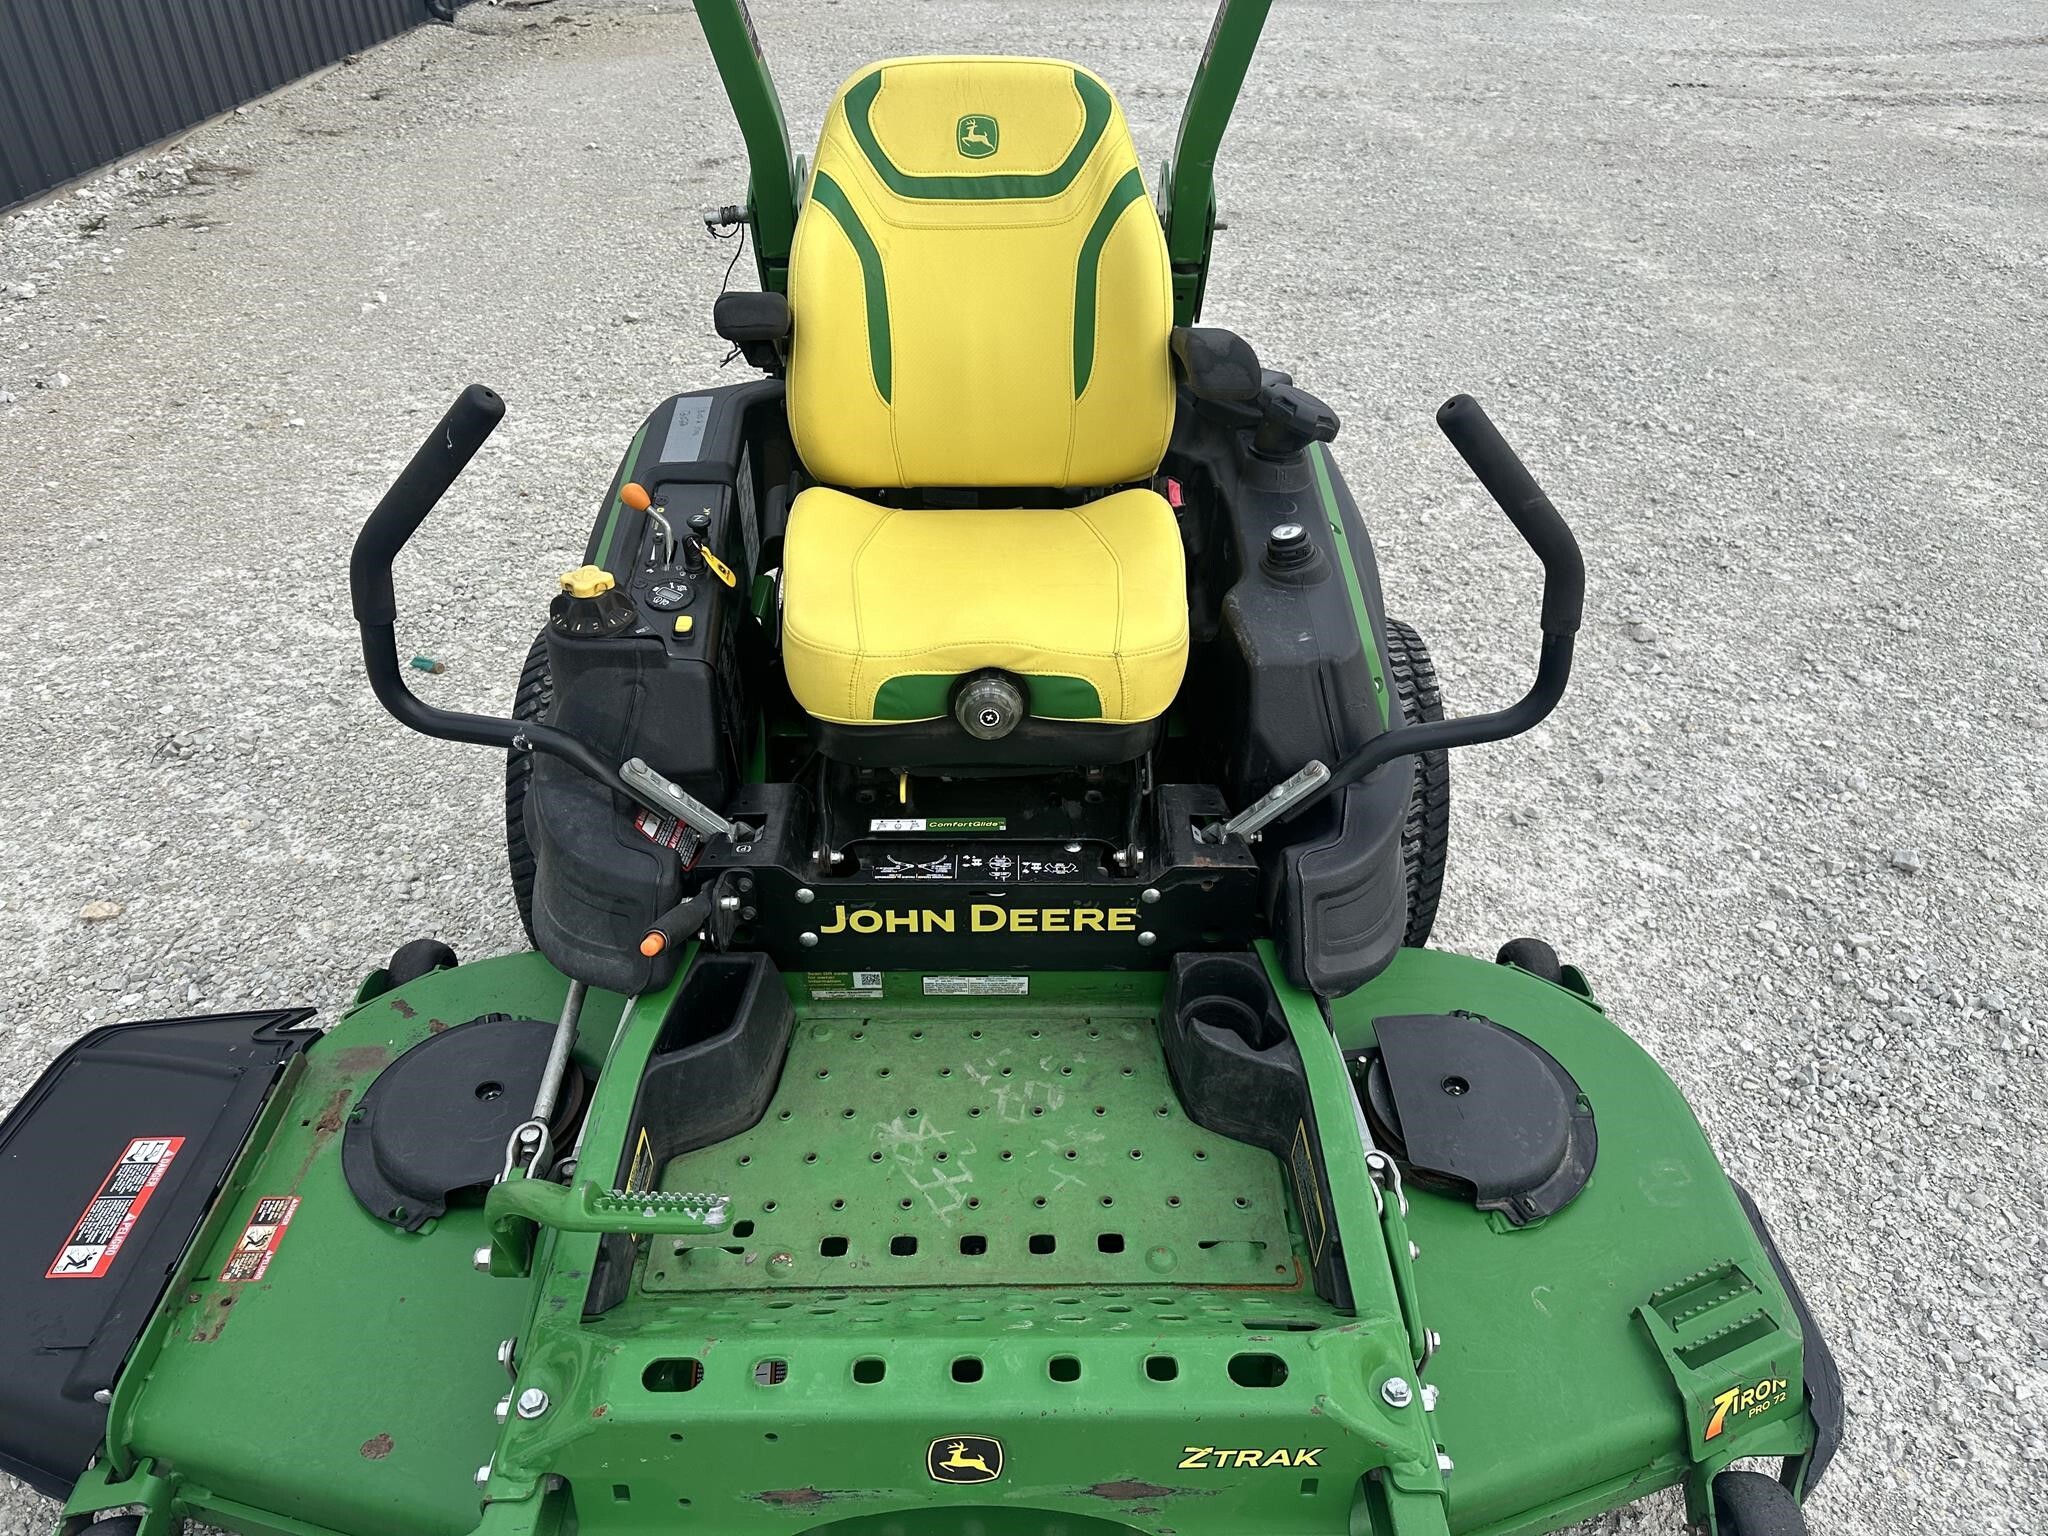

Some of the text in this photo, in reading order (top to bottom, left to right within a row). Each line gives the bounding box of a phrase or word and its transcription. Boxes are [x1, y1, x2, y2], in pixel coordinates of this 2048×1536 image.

[820, 904, 1137, 934] JOHN DEERE
[146, 1158, 170, 1187] DANGER
[105, 1221, 133, 1256] PELIGRO
[1748, 1392, 1786, 1418] PRO 72
[1178, 1446, 1325, 1469] ZTRAK
